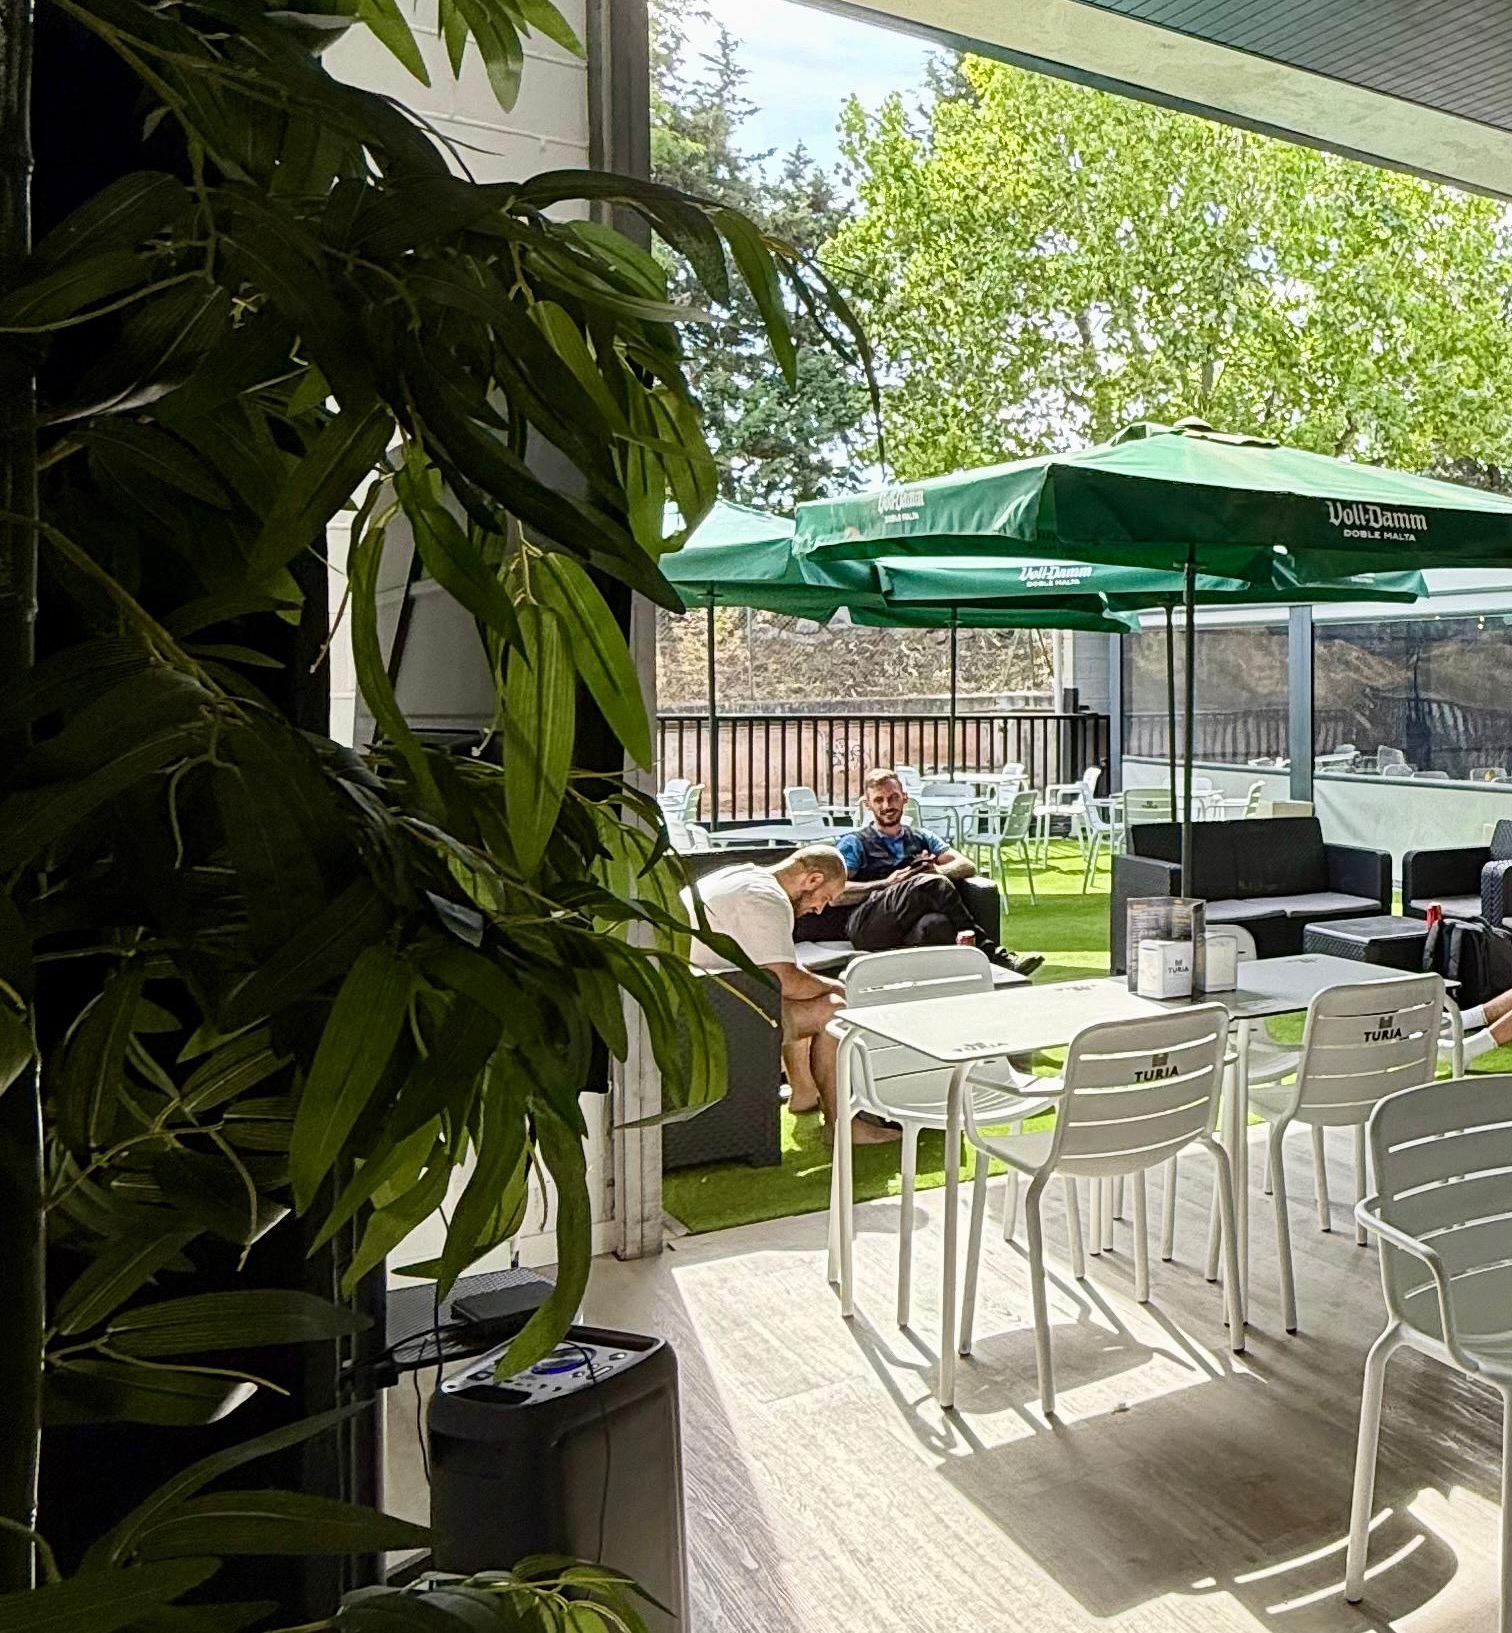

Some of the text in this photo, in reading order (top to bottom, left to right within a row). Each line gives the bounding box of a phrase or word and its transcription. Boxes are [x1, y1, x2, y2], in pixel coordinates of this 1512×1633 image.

[1325, 500, 1428, 530] Voll-Damm
[1343, 529, 1416, 541] DOBLE MALTA
[1168, 966, 1190, 974] TURIA
[1364, 1027, 1402, 1043] TURIA
[1134, 1065, 1179, 1083] TURIA
